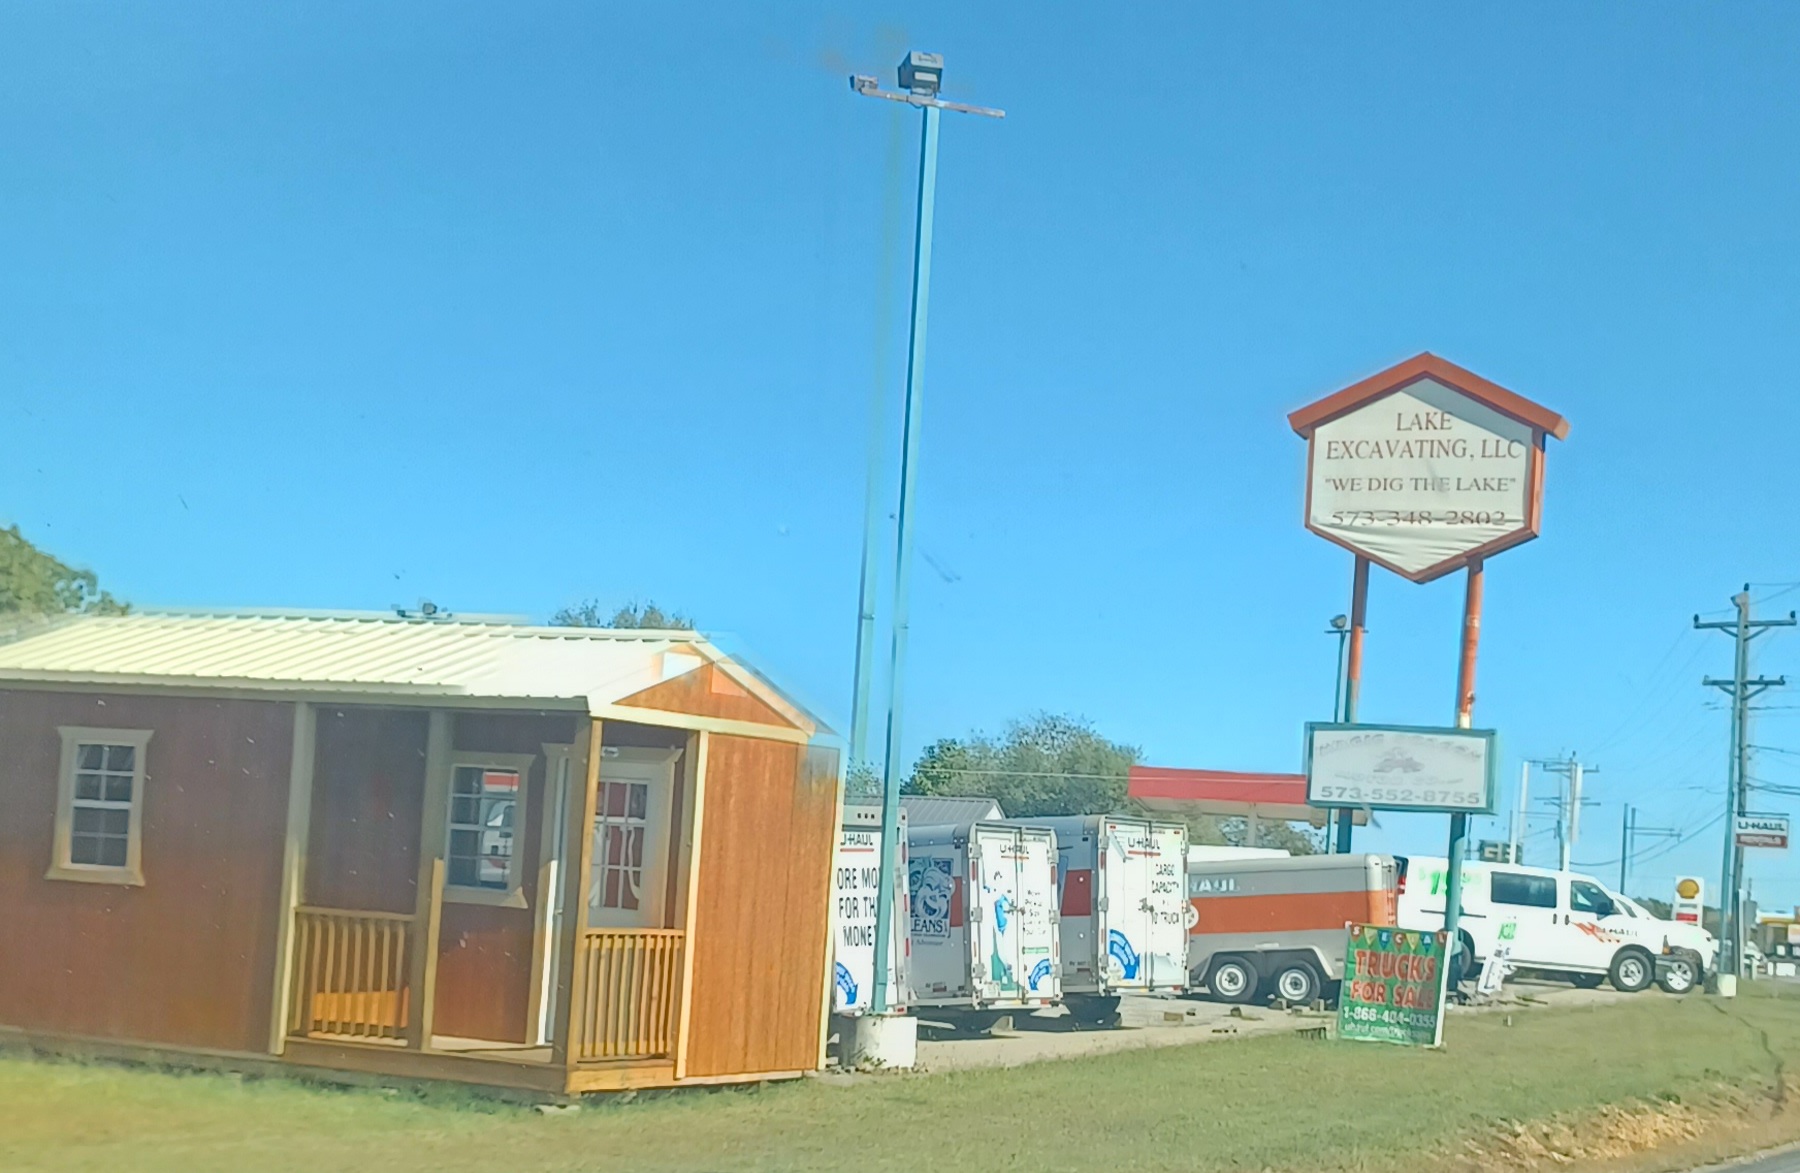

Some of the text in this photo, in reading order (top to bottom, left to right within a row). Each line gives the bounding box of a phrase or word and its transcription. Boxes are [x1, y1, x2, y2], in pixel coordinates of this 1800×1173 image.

[1397, 412, 1452, 431] LAKE
[1326, 439, 1522, 461] EXCAVATING, LLC
[1368, 478, 1403, 492] DIG
[1410, 478, 1451, 493] THE
[1331, 511, 1506, 527] 573-348-2802
[1321, 785, 1480, 804] 573-552-8755
[1738, 821, 1785, 831] U-HAUL
[1127, 836, 1160, 850] U-HAUL
[837, 867, 858, 890] ORE
[838, 896, 878, 919] FOR TH
[842, 925, 877, 947] MONE
[1354, 949, 1437, 983] TRUCKS
[1350, 980, 1437, 1011] FOR SALE
